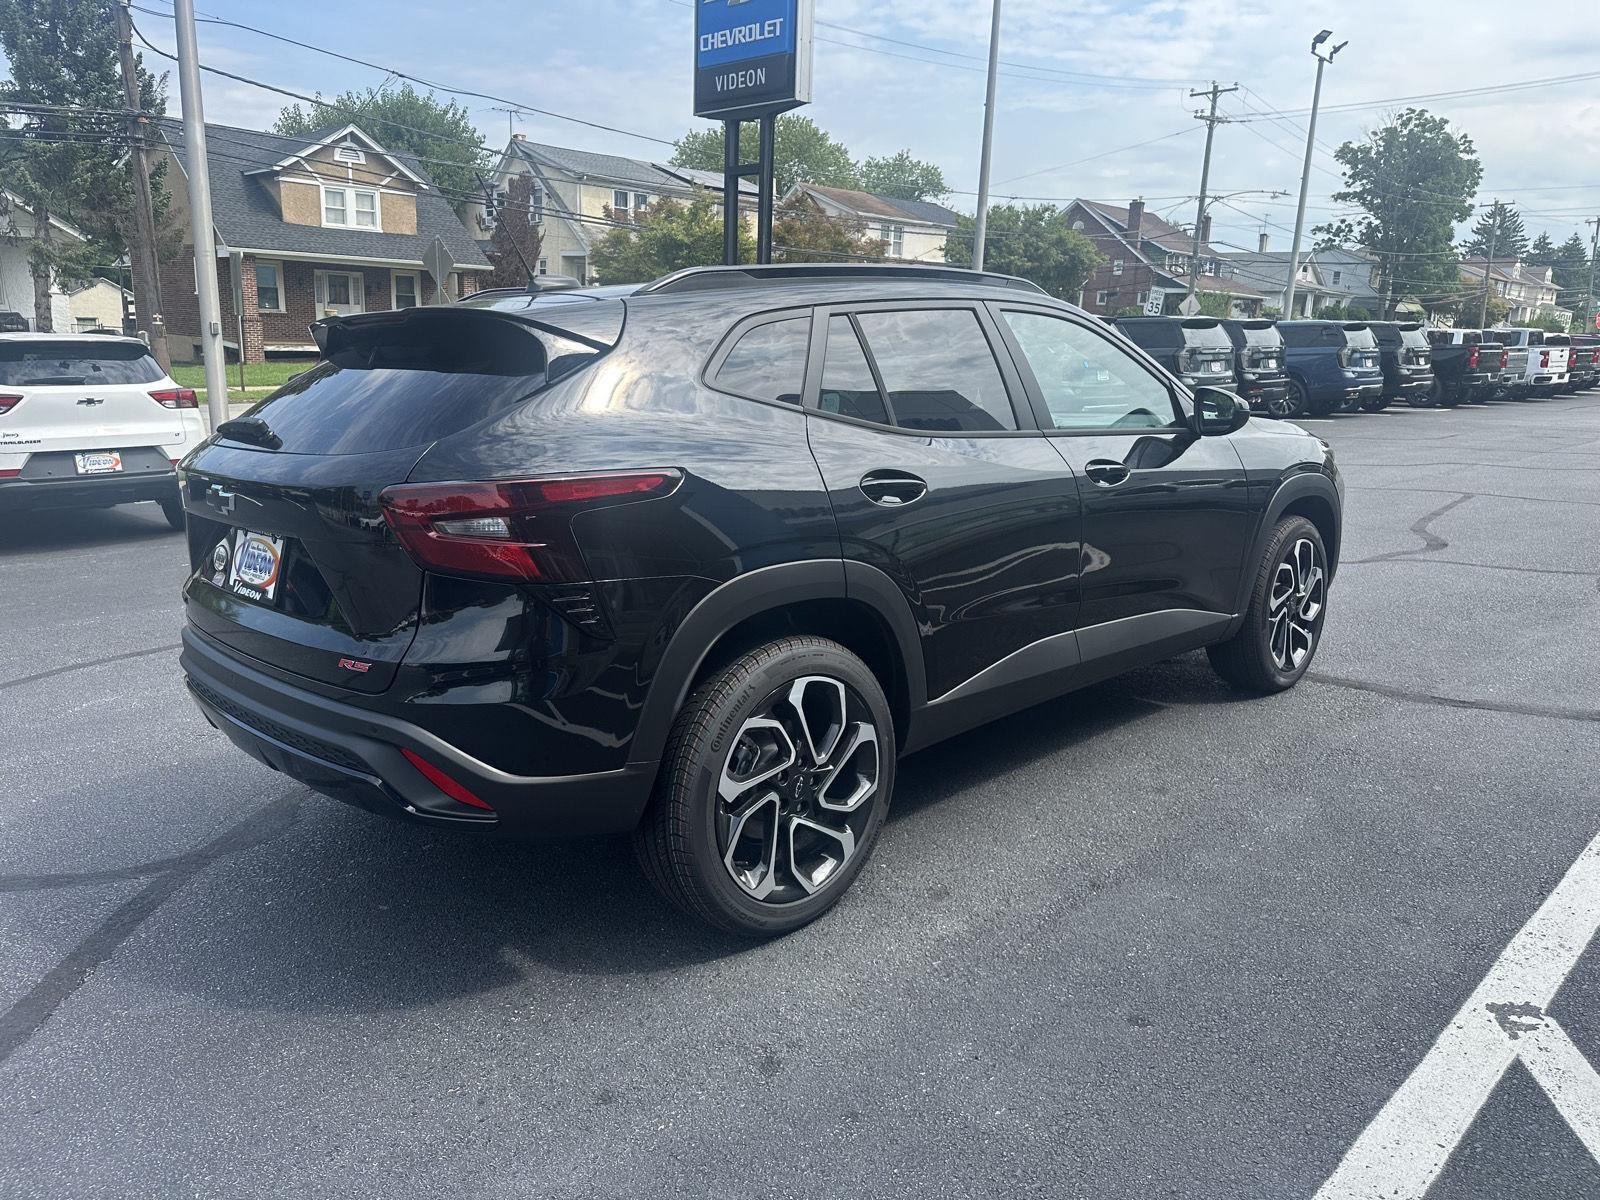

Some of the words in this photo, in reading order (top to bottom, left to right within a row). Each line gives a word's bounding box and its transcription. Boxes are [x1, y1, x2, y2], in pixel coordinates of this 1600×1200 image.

[700, 18, 784, 52] CHEVROLET
[715, 67, 766, 92] VIDEON
[1147, 301, 1161, 314] 35
[233, 580, 262, 601] VIDEON
[338, 658, 372, 673] RS
[710, 689, 751, 753] Continental
